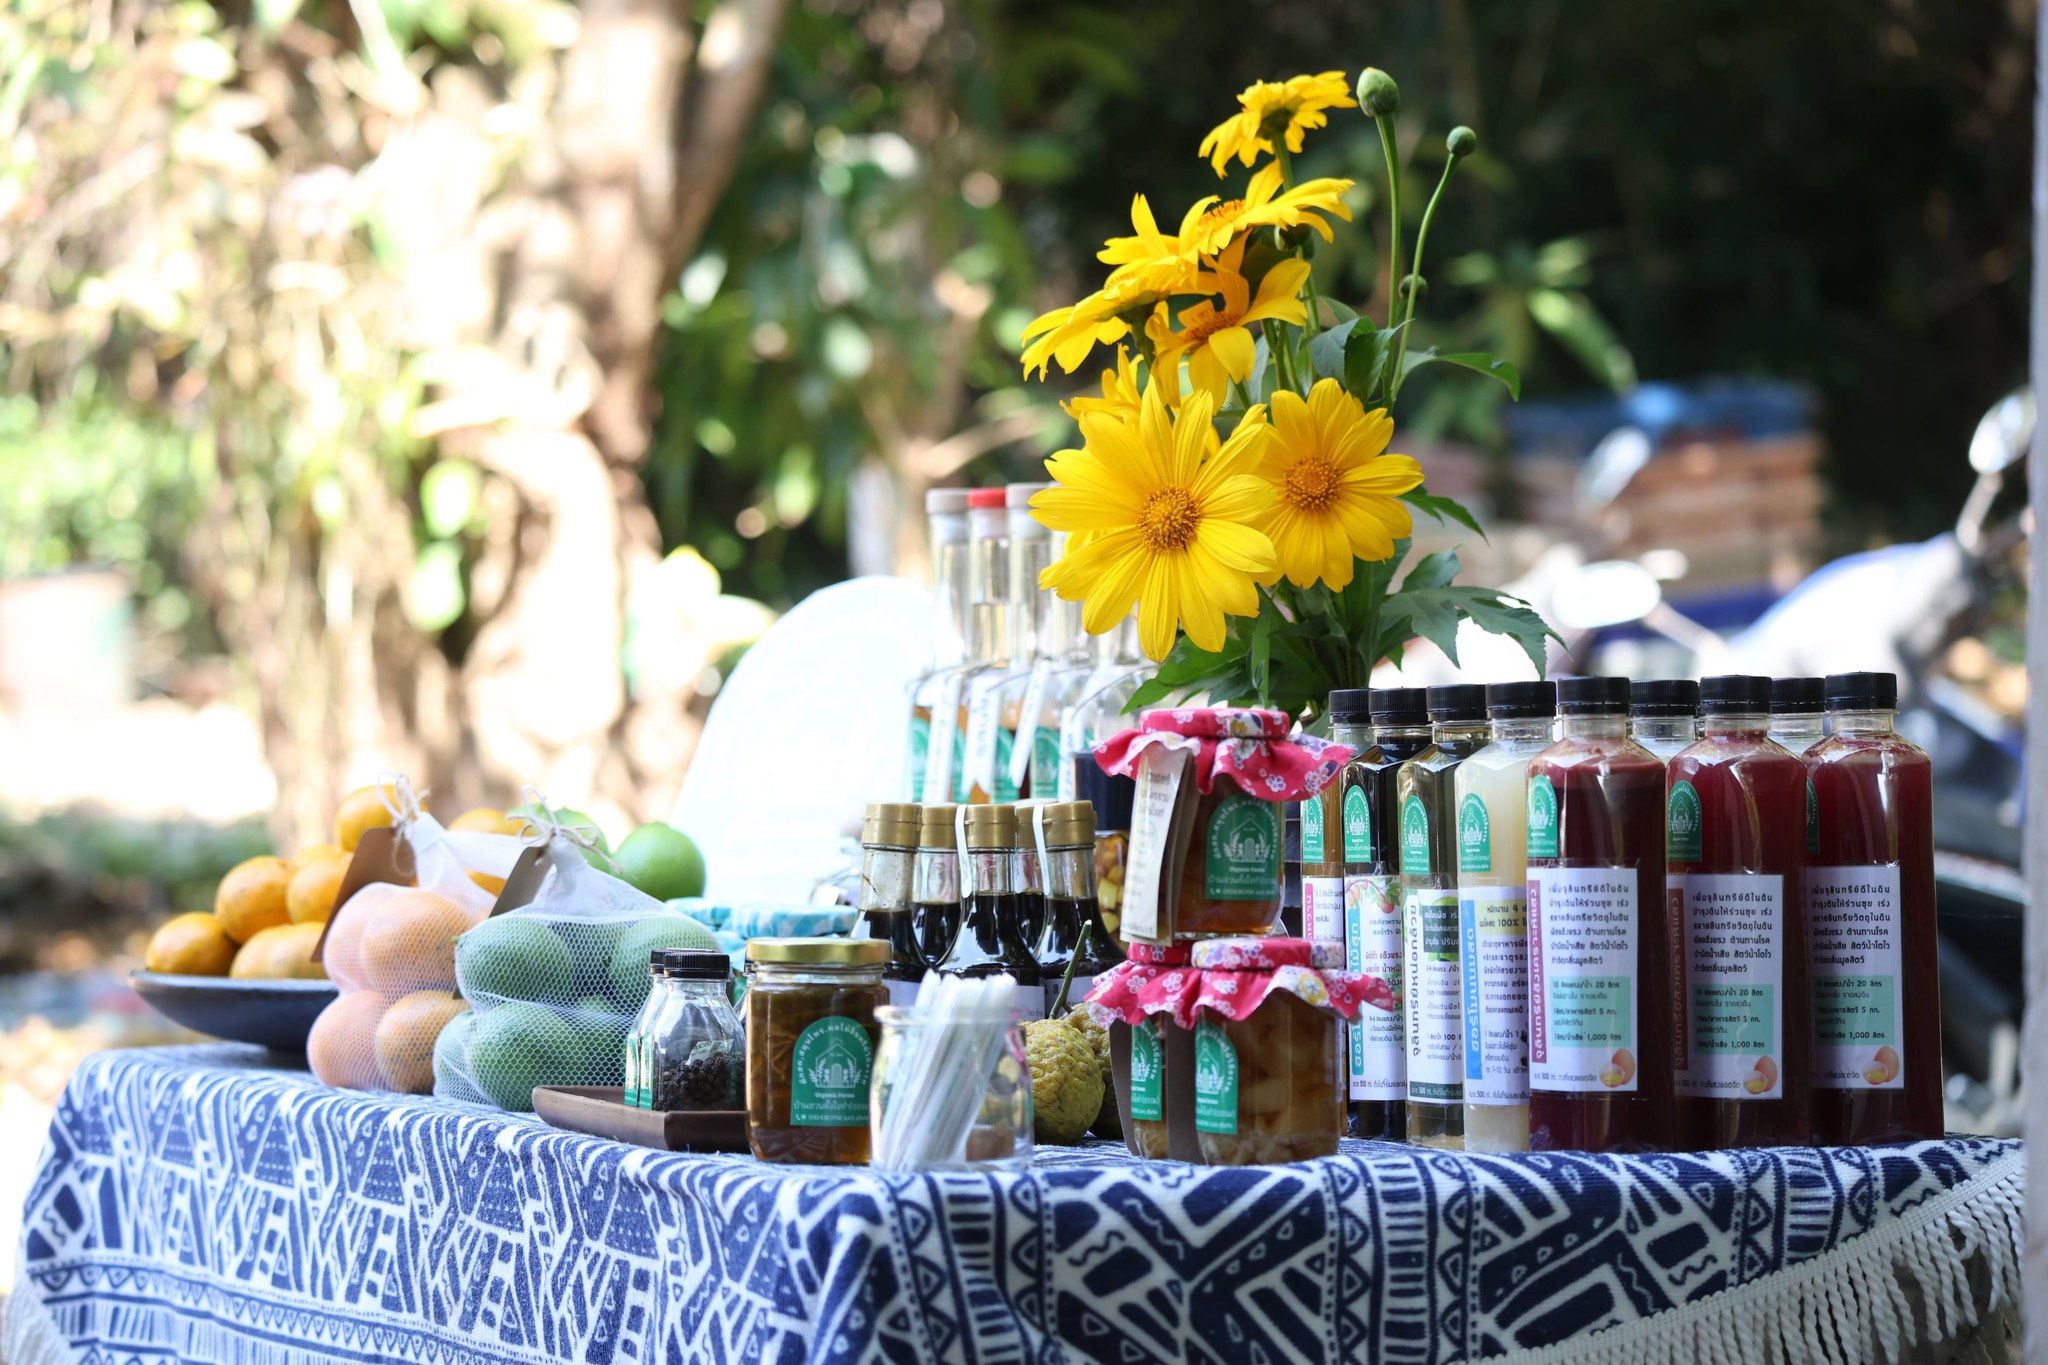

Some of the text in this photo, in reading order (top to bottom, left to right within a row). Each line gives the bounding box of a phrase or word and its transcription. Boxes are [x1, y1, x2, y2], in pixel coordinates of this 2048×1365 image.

[1617, 898, 1629, 907] เร่ง
[1878, 899, 1890, 908] เร่ง
[1761, 907, 1772, 916] เร่ง
[1498, 918, 1519, 927] 100%
[1466, 928, 1479, 1052] ฮอร์โมนนมสด
[1587, 1033, 1607, 1041] 1,000
[1731, 1041, 1750, 1049] 1,000
